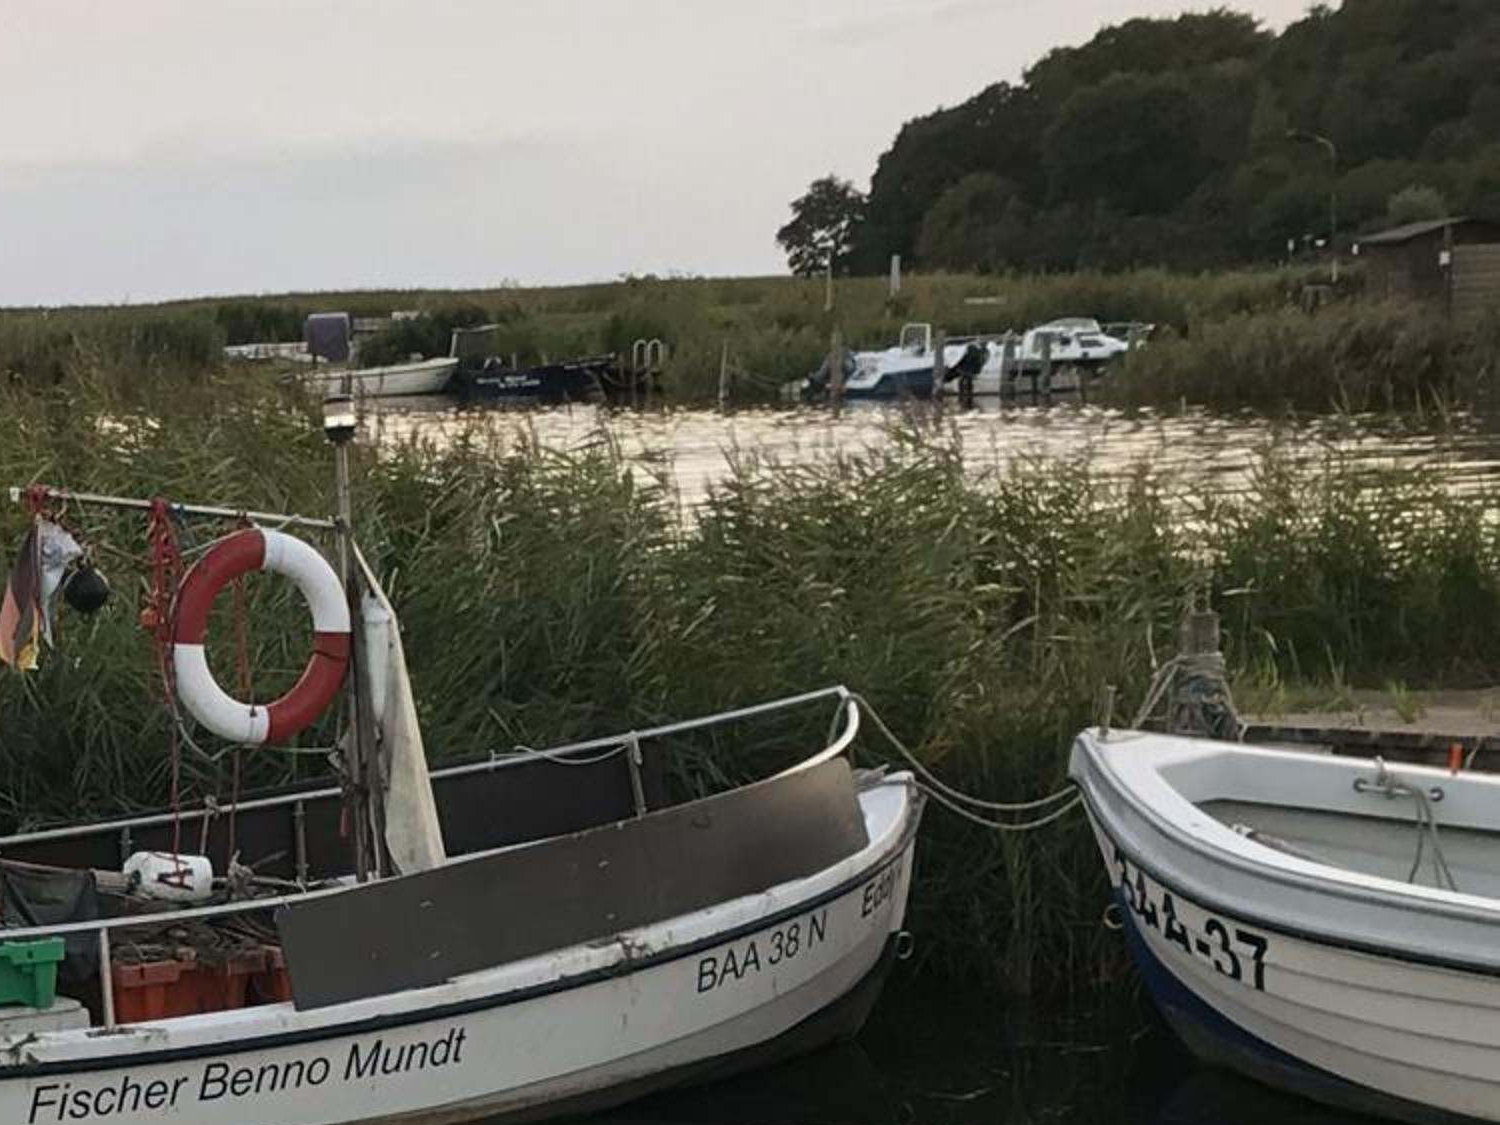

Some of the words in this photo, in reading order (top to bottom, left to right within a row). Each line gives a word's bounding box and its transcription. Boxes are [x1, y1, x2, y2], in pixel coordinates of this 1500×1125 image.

[698, 942, 760, 993] BAA
[769, 924, 800, 965] 38
[807, 911, 827, 948] N
[28, 1076, 188, 1125] Fischer
[198, 1056, 330, 1101] Benno
[343, 1028, 467, 1080] Mundt
